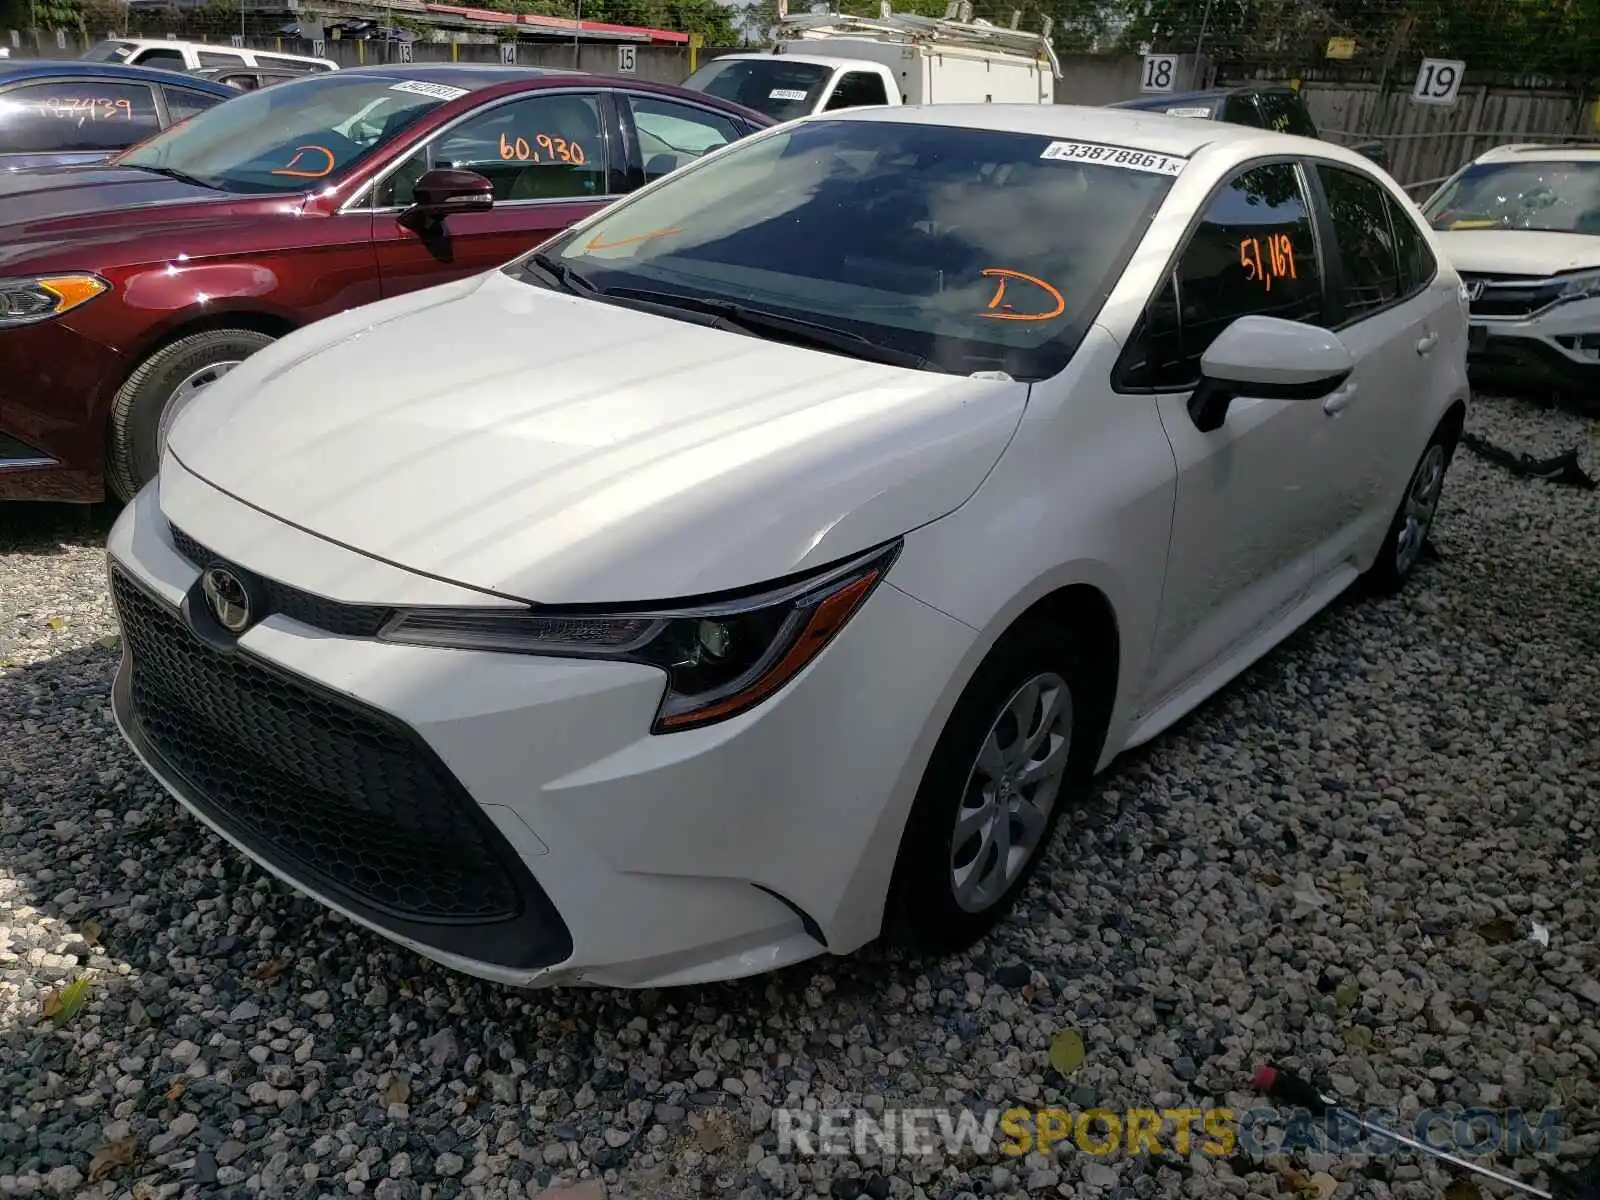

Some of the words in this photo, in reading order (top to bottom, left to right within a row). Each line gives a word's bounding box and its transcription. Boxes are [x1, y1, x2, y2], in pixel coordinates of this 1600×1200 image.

[314, 41, 324, 57] 12
[400, 43, 412, 63] 13
[502, 46, 516, 64] 14
[620, 49, 635, 70] 15
[1146, 60, 1172, 88] 18
[1419, 64, 1456, 98] 19
[500, 133, 584, 164] 60,930
[1062, 144, 1169, 169] 33878861
[1240, 233, 1296, 291] 51,169
